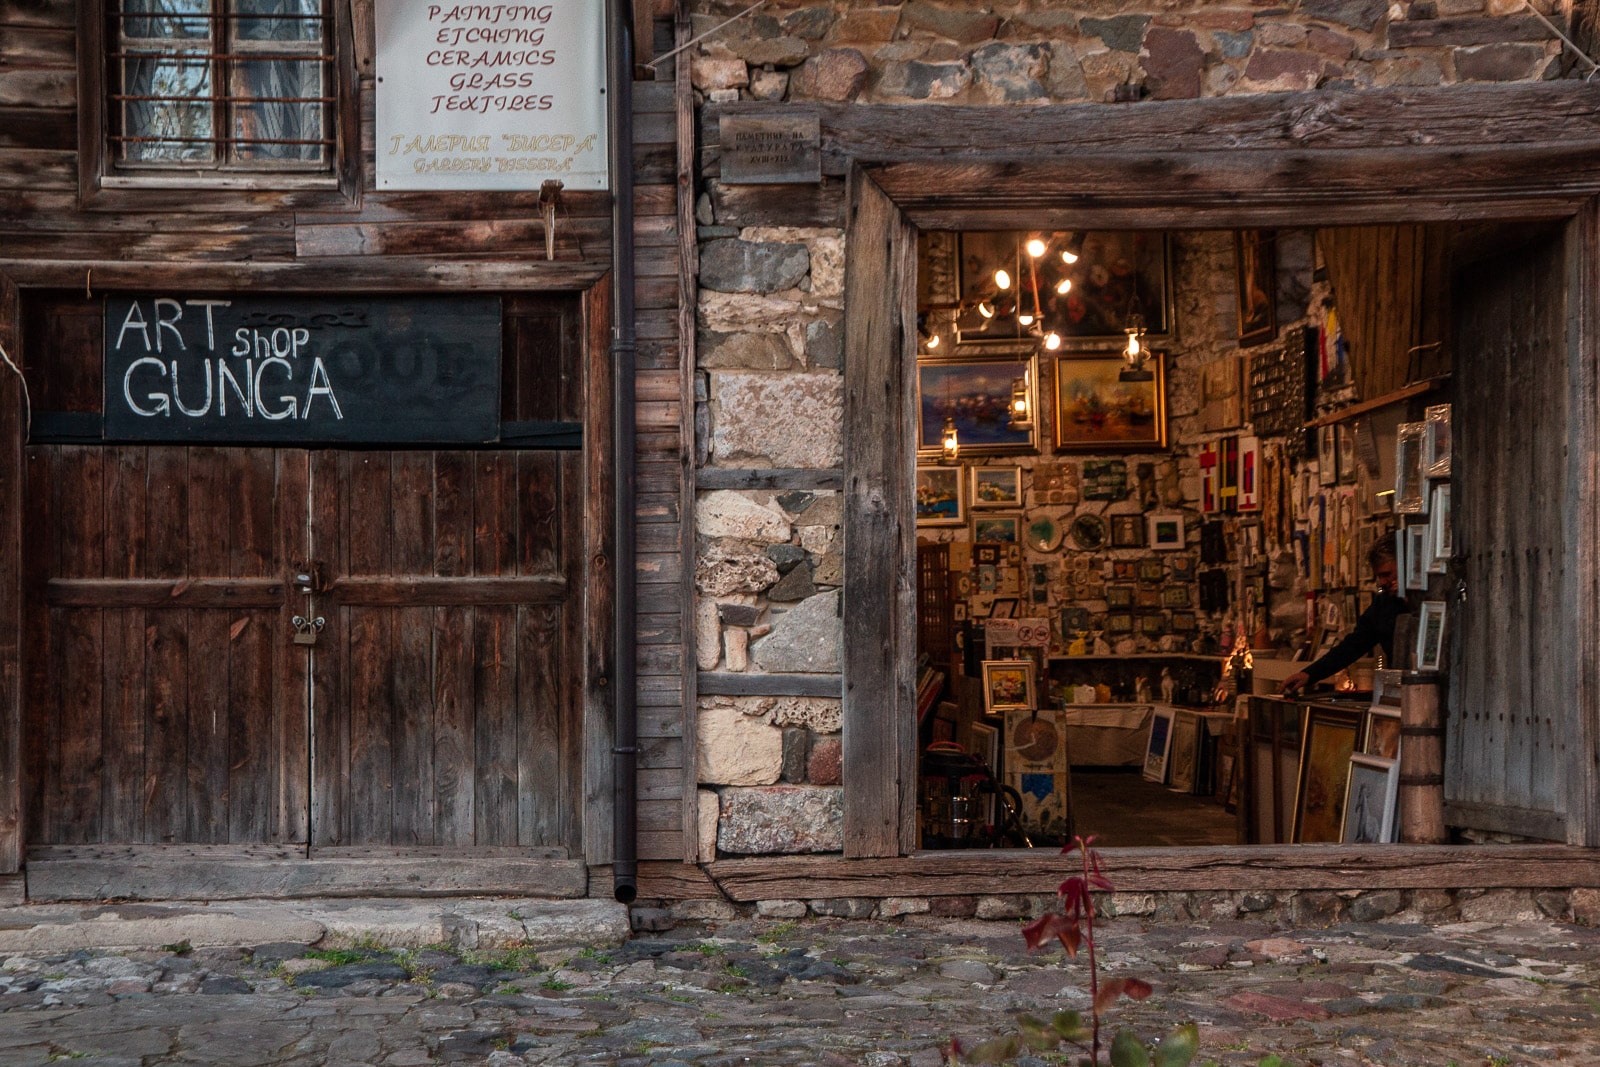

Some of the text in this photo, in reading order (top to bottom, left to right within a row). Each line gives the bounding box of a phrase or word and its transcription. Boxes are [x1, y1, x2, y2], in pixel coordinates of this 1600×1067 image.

[428, 5, 553, 24] PAINTING
[436, 27, 545, 46] ETCHING
[426, 50, 556, 68] CERAMICS
[449, 72, 534, 91] GLASS
[430, 95, 554, 114] TEXTILES
[389, 134, 491, 155] ГАЛЕРИЯ
[115, 298, 232, 353] ART
[123, 357, 343, 420] GUNGA
